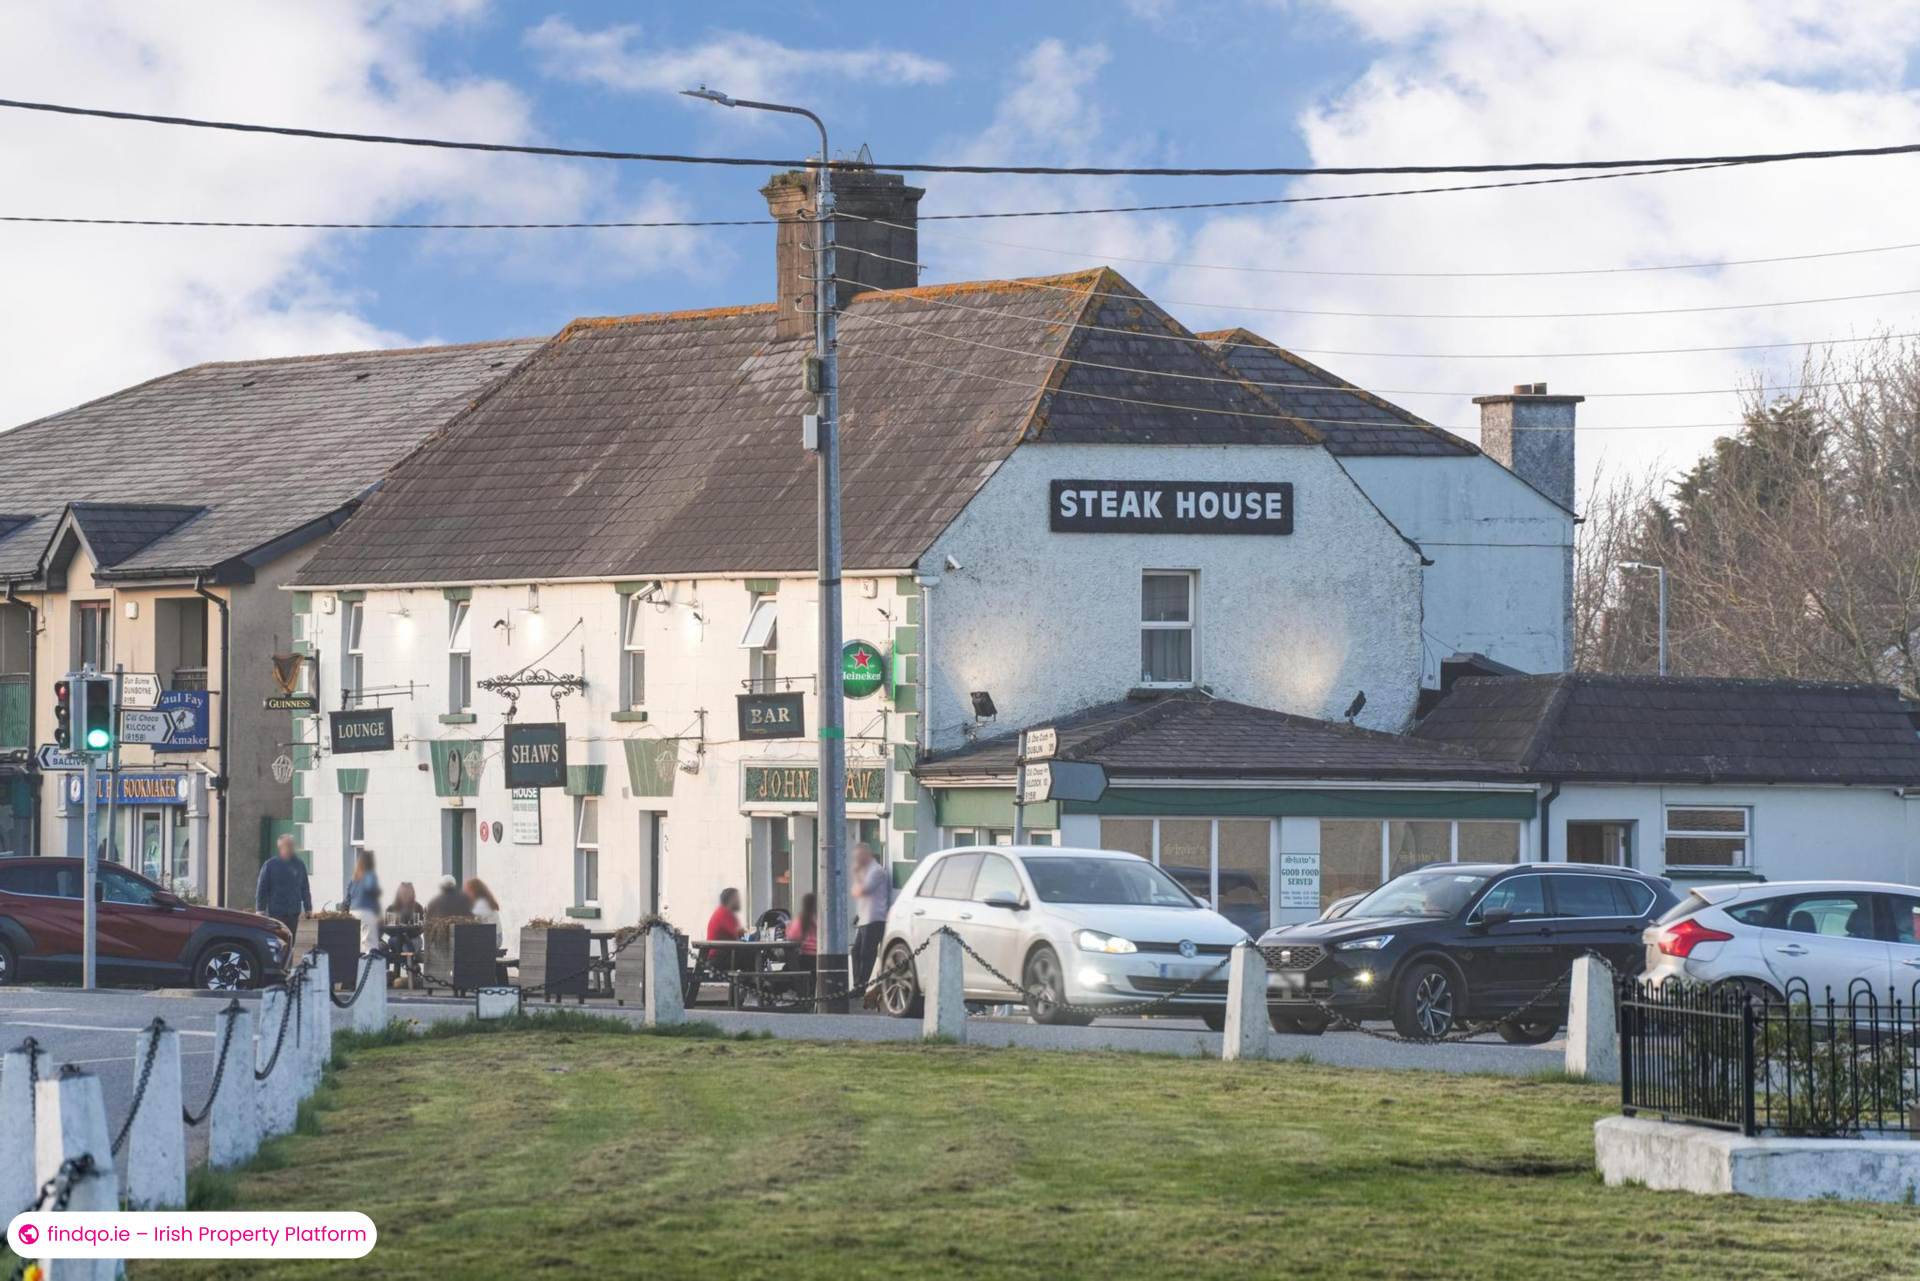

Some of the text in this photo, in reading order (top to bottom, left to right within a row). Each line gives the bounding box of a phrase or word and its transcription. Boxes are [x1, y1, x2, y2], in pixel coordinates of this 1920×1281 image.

[1060, 490, 1283, 520] STEAK HOUSE
[124, 687, 152, 695] DUNBOYNE
[184, 693, 204, 708] Fay
[268, 699, 311, 709] GUINNESS
[751, 707, 791, 725] BAR
[126, 723, 156, 732] KILCOCK
[338, 722, 385, 739] LOUNGE
[511, 743, 559, 764] SHAWS
[123, 778, 177, 798] BOOKMAKER
[758, 769, 873, 799] JOHN AW
[1281, 868, 1319, 876] GOOD FOOD
[1287, 878, 1313, 886] SERVED
